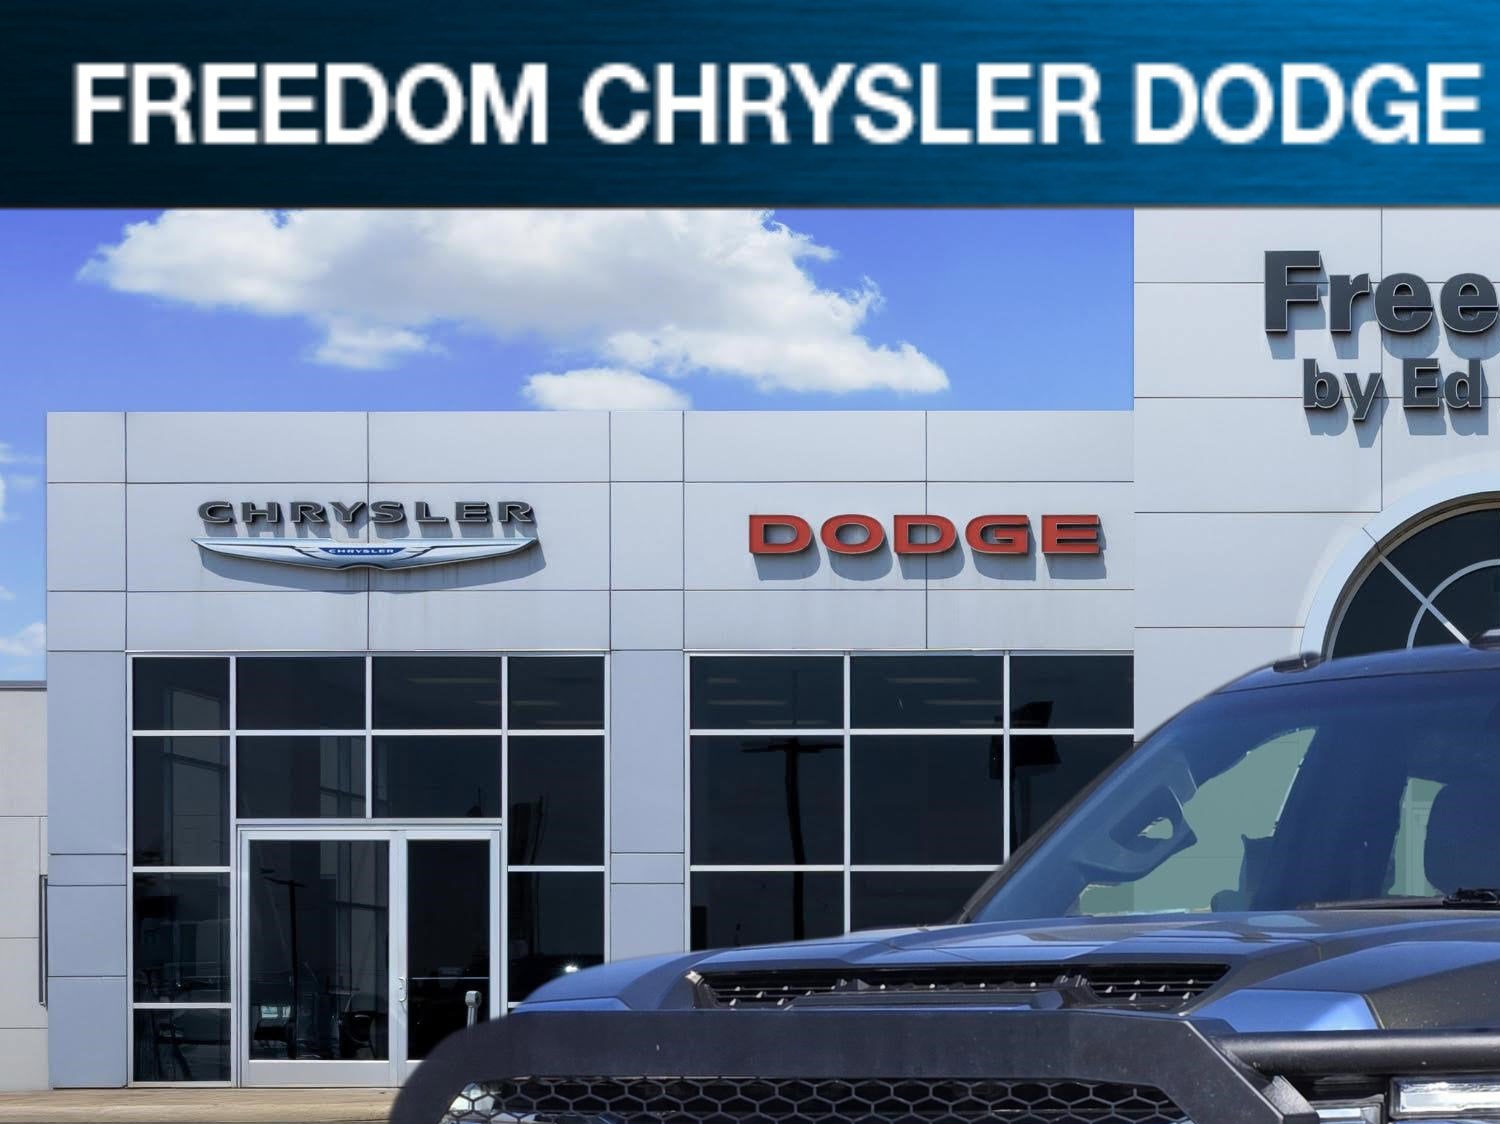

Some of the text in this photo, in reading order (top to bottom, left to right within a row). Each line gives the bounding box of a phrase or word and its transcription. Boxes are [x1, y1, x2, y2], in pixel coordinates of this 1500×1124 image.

[1303, 358, 1383, 421] by
[1402, 358, 1483, 408] Ed
[198, 500, 535, 524] CHRYSLER
[748, 513, 1101, 555] DODGE
